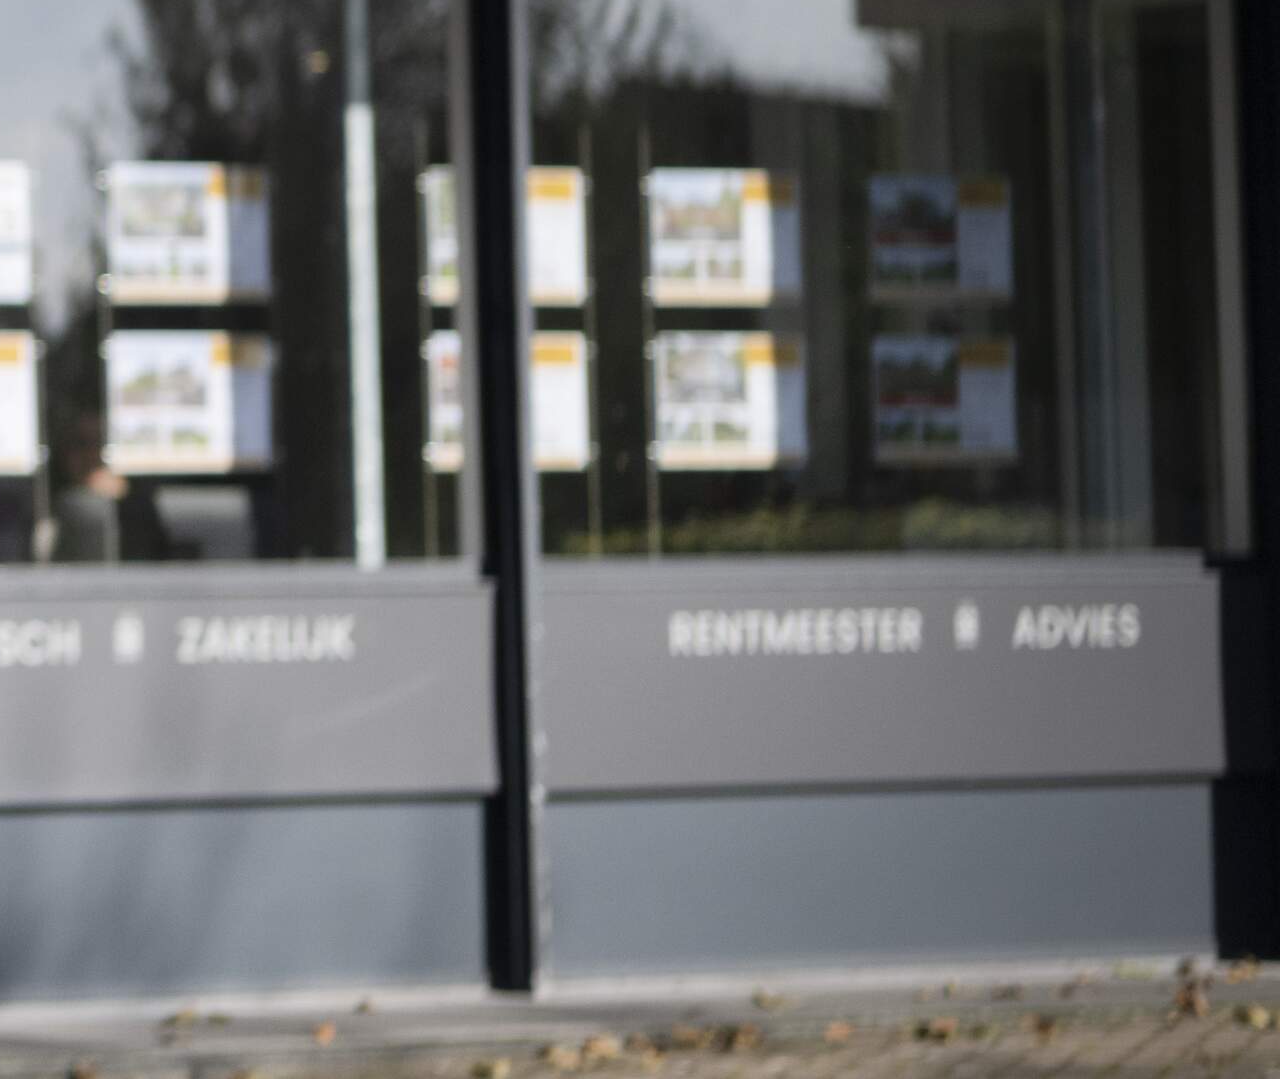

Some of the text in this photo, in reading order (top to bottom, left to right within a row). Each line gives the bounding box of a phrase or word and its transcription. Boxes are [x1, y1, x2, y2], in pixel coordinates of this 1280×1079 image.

[176, 615, 356, 665] ZAKELIJK
[669, 603, 1141, 657] RENTMEESTER ADVIES
